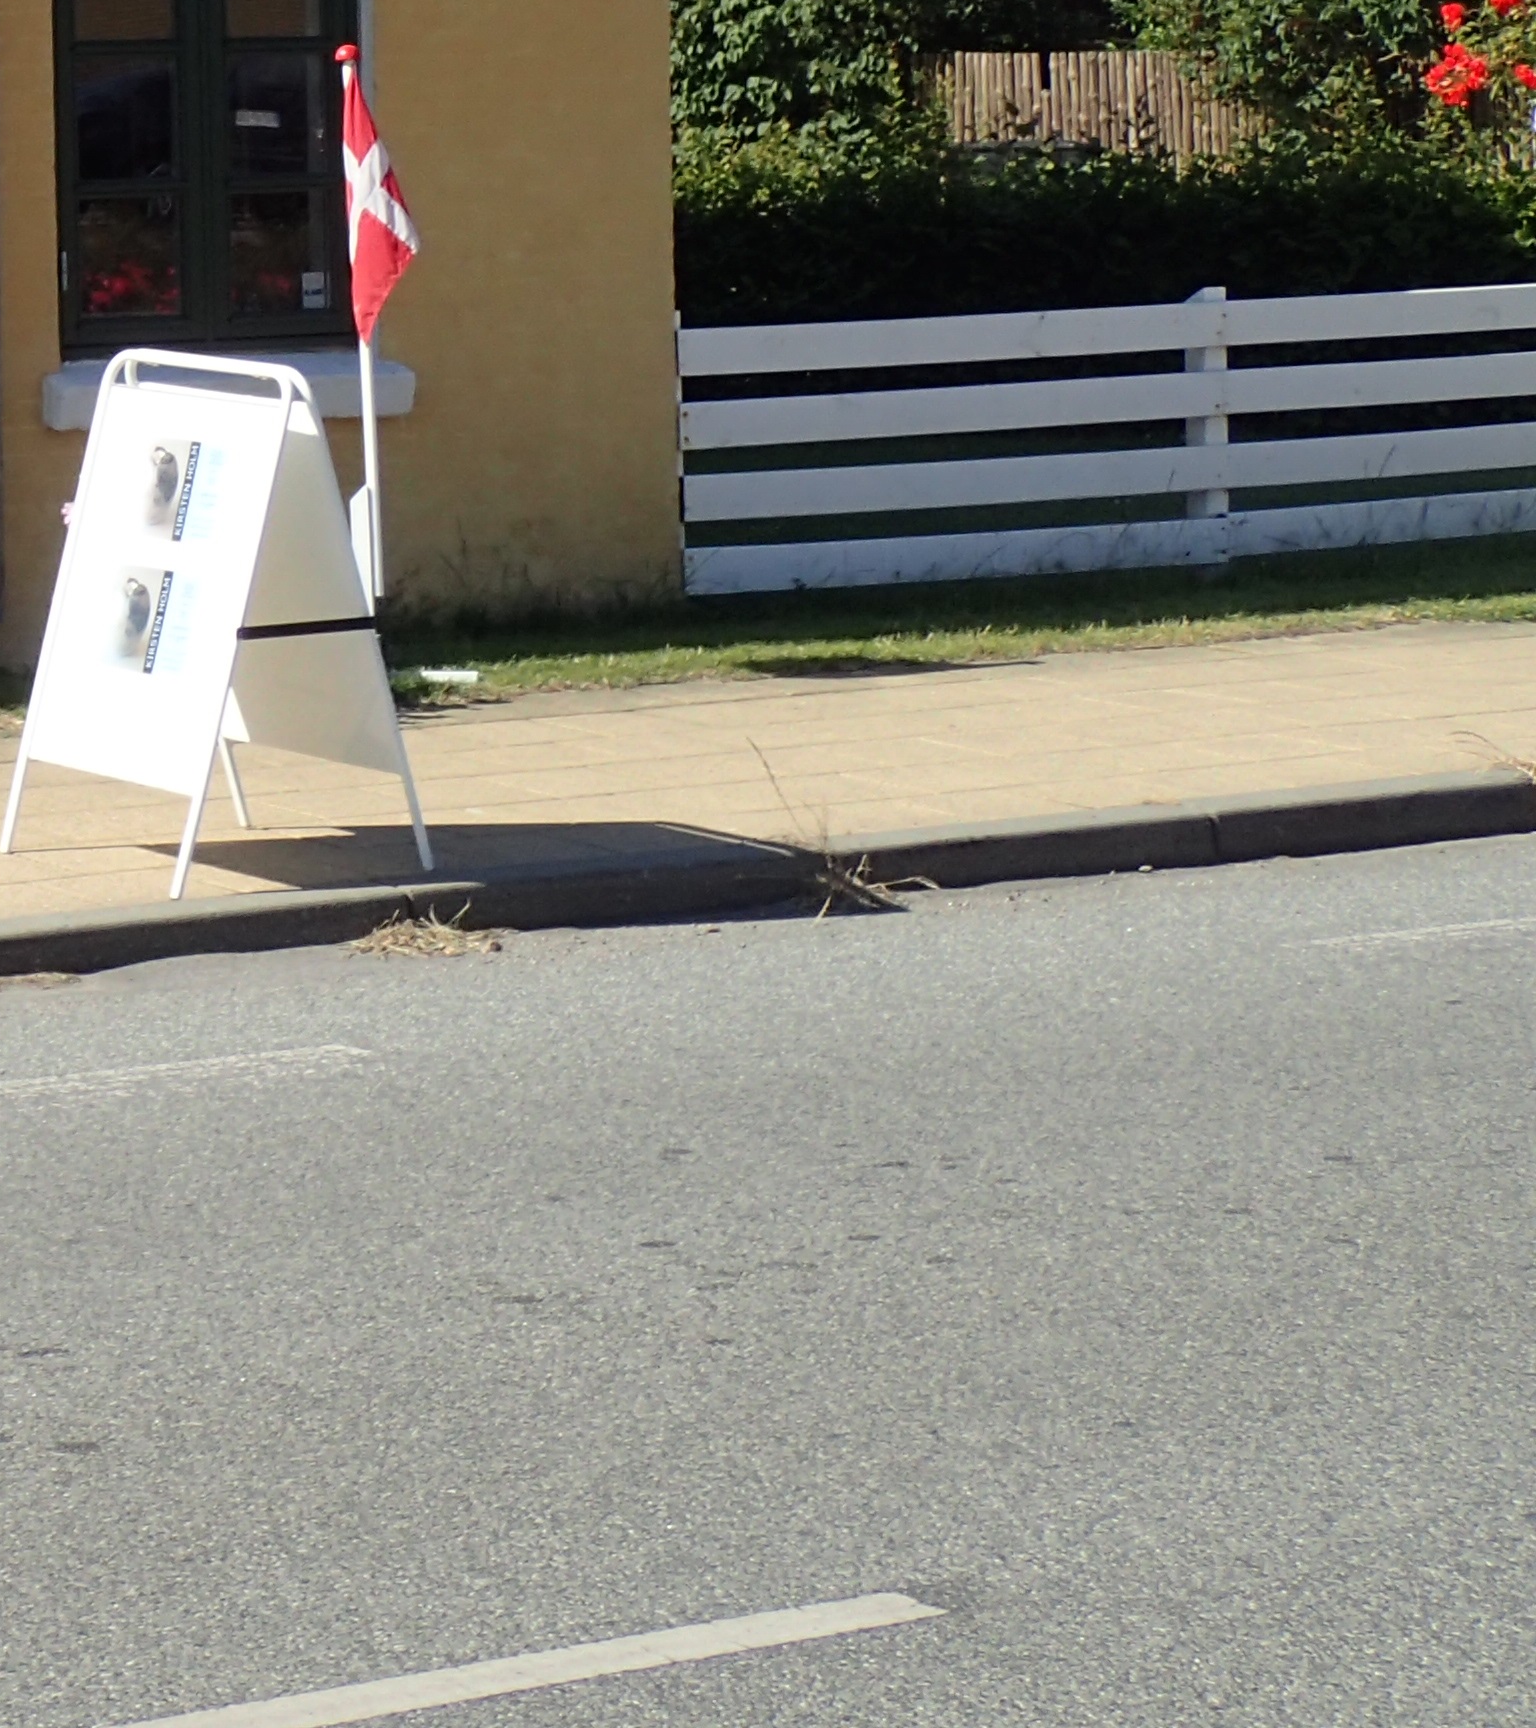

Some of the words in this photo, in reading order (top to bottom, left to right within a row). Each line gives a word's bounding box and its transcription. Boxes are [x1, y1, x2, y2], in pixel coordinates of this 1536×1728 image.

[174, 483, 191, 536] KIRSTEN
[186, 445, 200, 480] HOLM
[145, 616, 163, 668] KIRSTEN
[158, 577, 171, 612] HOLM
